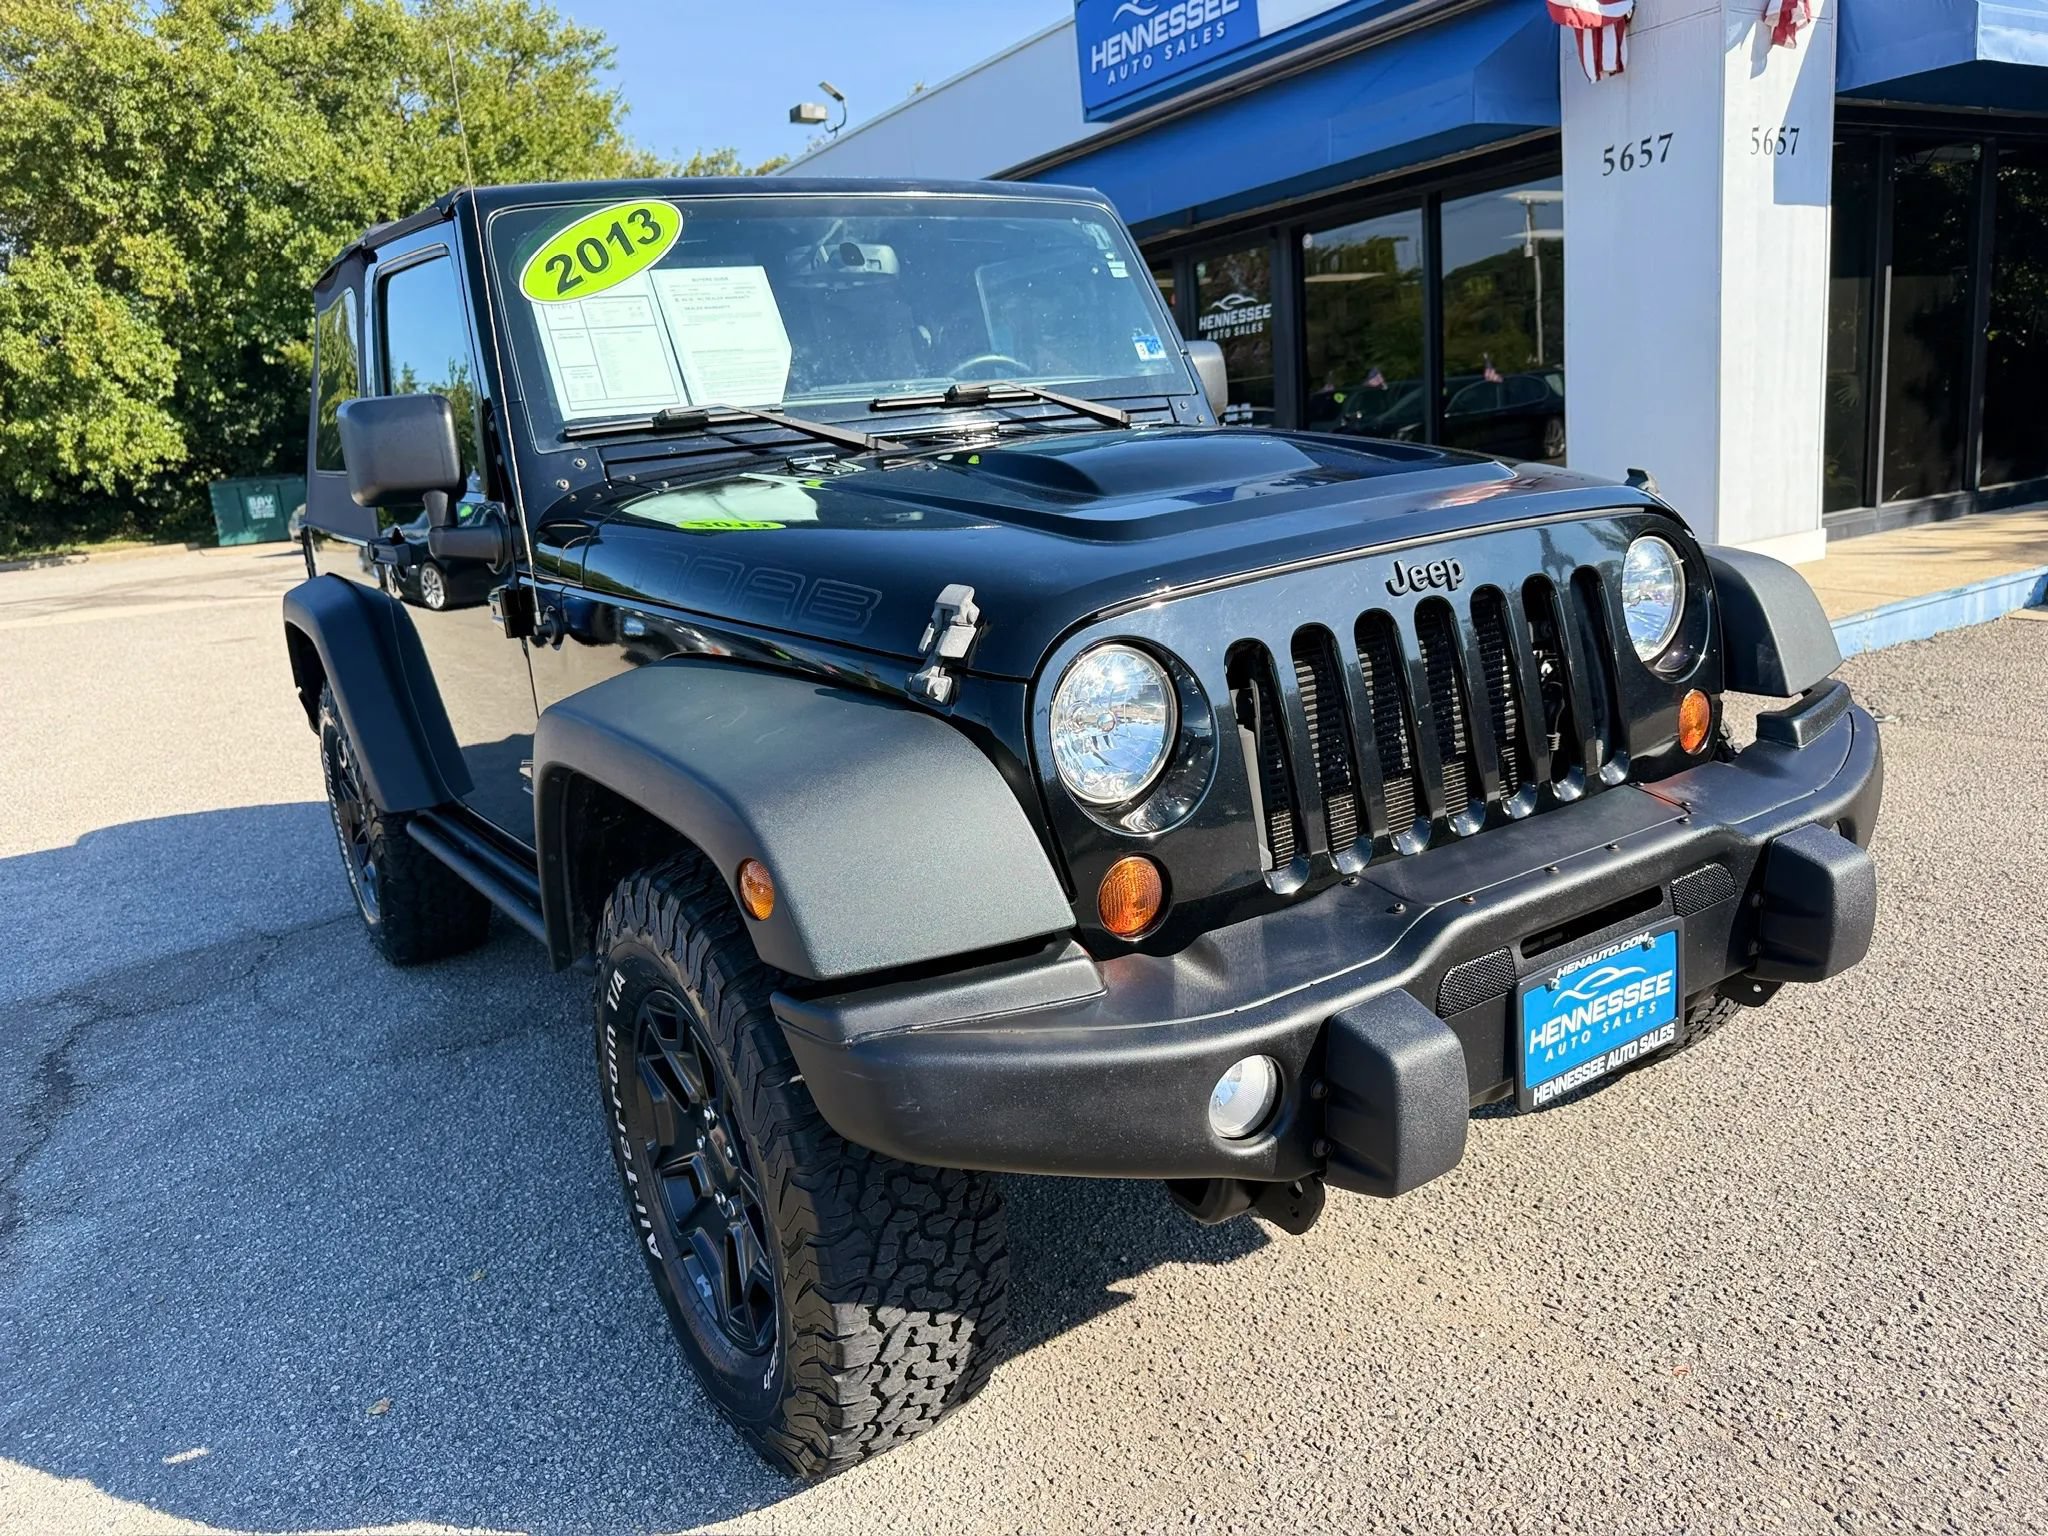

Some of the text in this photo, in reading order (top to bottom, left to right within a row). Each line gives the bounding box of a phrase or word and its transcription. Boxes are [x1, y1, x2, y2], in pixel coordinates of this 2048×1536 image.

[1107, 21, 1226, 86] AUTO SALES
[1602, 132, 1674, 176] 5657
[1750, 126, 1800, 156] 5657
[545, 207, 664, 297] 2013
[1198, 303, 1272, 331] HENNESSEE
[1206, 321, 1264, 341] AUTO SALES
[1385, 557, 1466, 597] Jeep
[1556, 931, 1651, 979] HENAUTO.COM
[1529, 970, 1673, 1054] HENNESSEE
[1544, 1000, 1658, 1063] AUTO SALES
[1532, 1022, 1676, 1107] HENNESSEE AUTO SALES
[606, 968, 664, 1261] All-Terrain T/A
